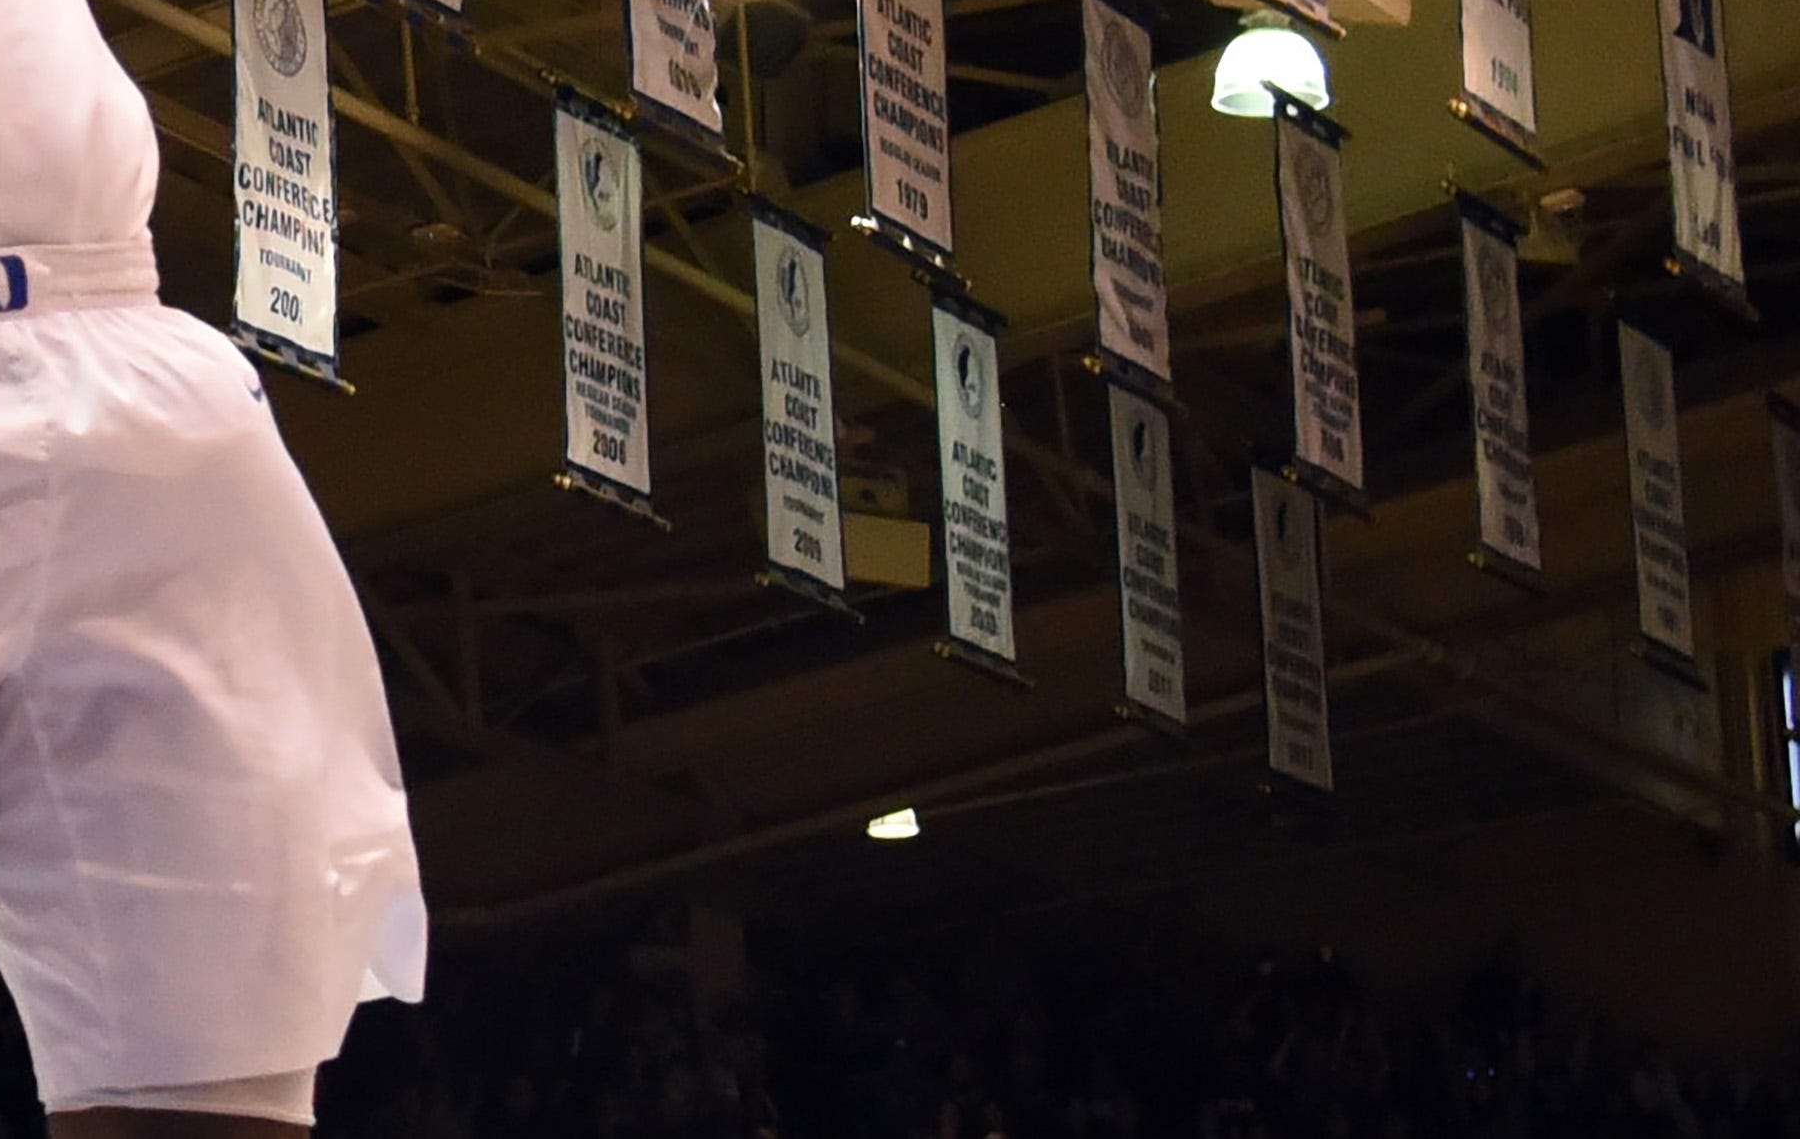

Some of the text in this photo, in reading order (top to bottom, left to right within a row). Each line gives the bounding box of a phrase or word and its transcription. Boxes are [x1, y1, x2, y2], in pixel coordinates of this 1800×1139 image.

[257, 97, 320, 150] ATLANTIC
[268, 137, 311, 178] COAST
[586, 290, 626, 328] COAST
[564, 313, 643, 371] CONFERENCE
[569, 349, 641, 404] CHAMPIONS
